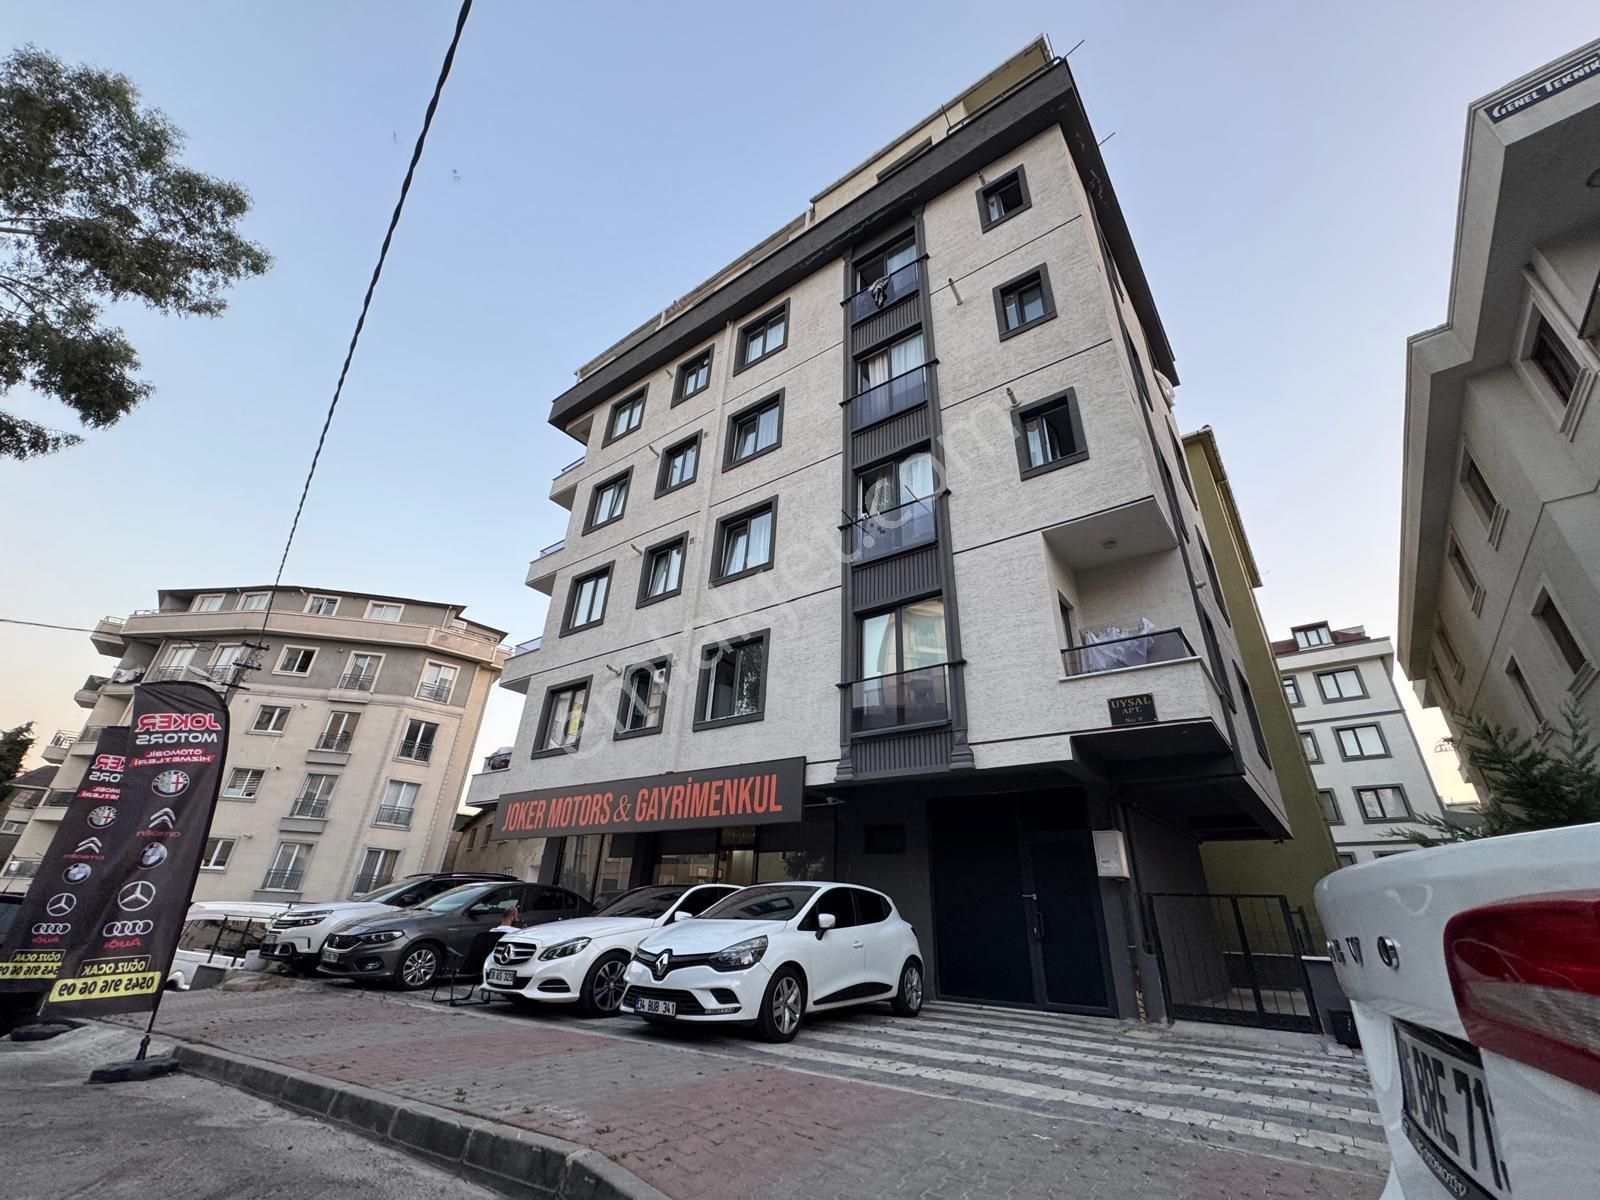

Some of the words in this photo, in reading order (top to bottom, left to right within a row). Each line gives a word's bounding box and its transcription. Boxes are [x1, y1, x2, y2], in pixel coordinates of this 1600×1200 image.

[1492, 89, 1541, 117] GENEL
[1111, 697, 1152, 708] UYSAL
[502, 799, 546, 832] JOKER
[547, 792, 614, 828] MOTORS
[613, 794, 631, 822] &
[635, 774, 783, 822] GAYRİMENKUL
[662, 1002, 675, 1015] 341
[1411, 1045, 1460, 1157] BRE
[1452, 1067, 1512, 1194] 71
